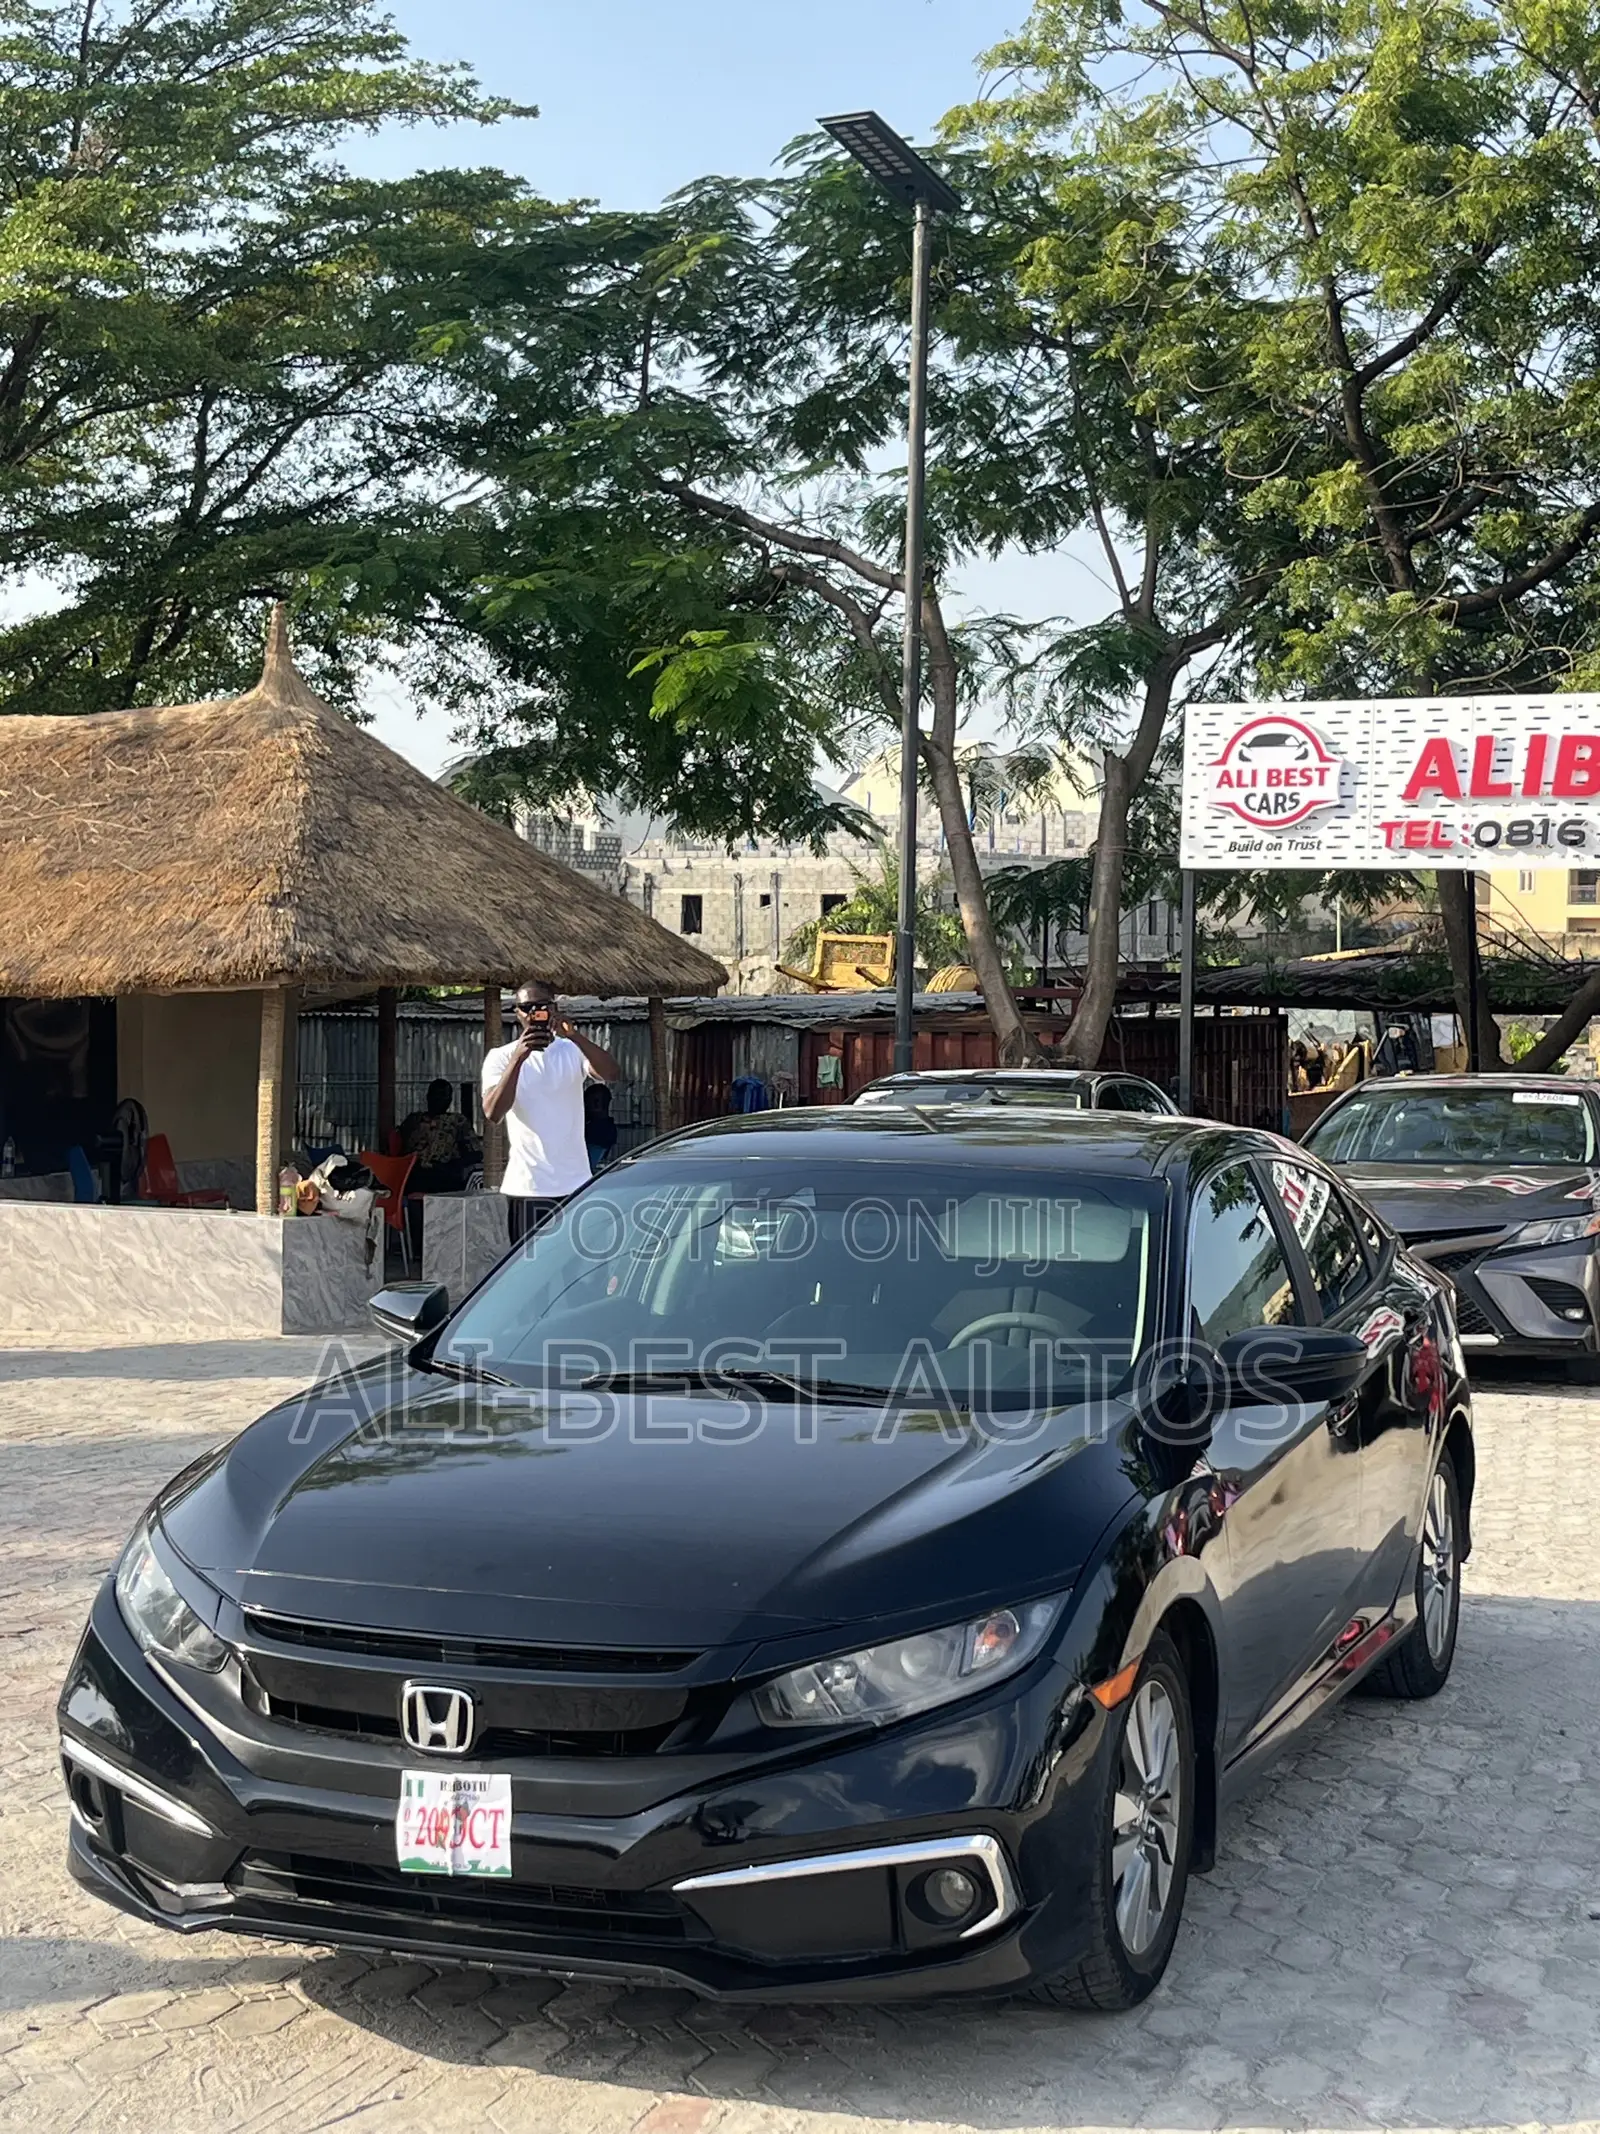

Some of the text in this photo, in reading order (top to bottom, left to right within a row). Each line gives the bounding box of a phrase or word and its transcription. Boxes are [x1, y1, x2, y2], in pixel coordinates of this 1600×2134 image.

[1216, 767, 1331, 788] ALI BEST
[1244, 791, 1300, 815] CARS
[1228, 839, 1323, 853] Build on Trust
